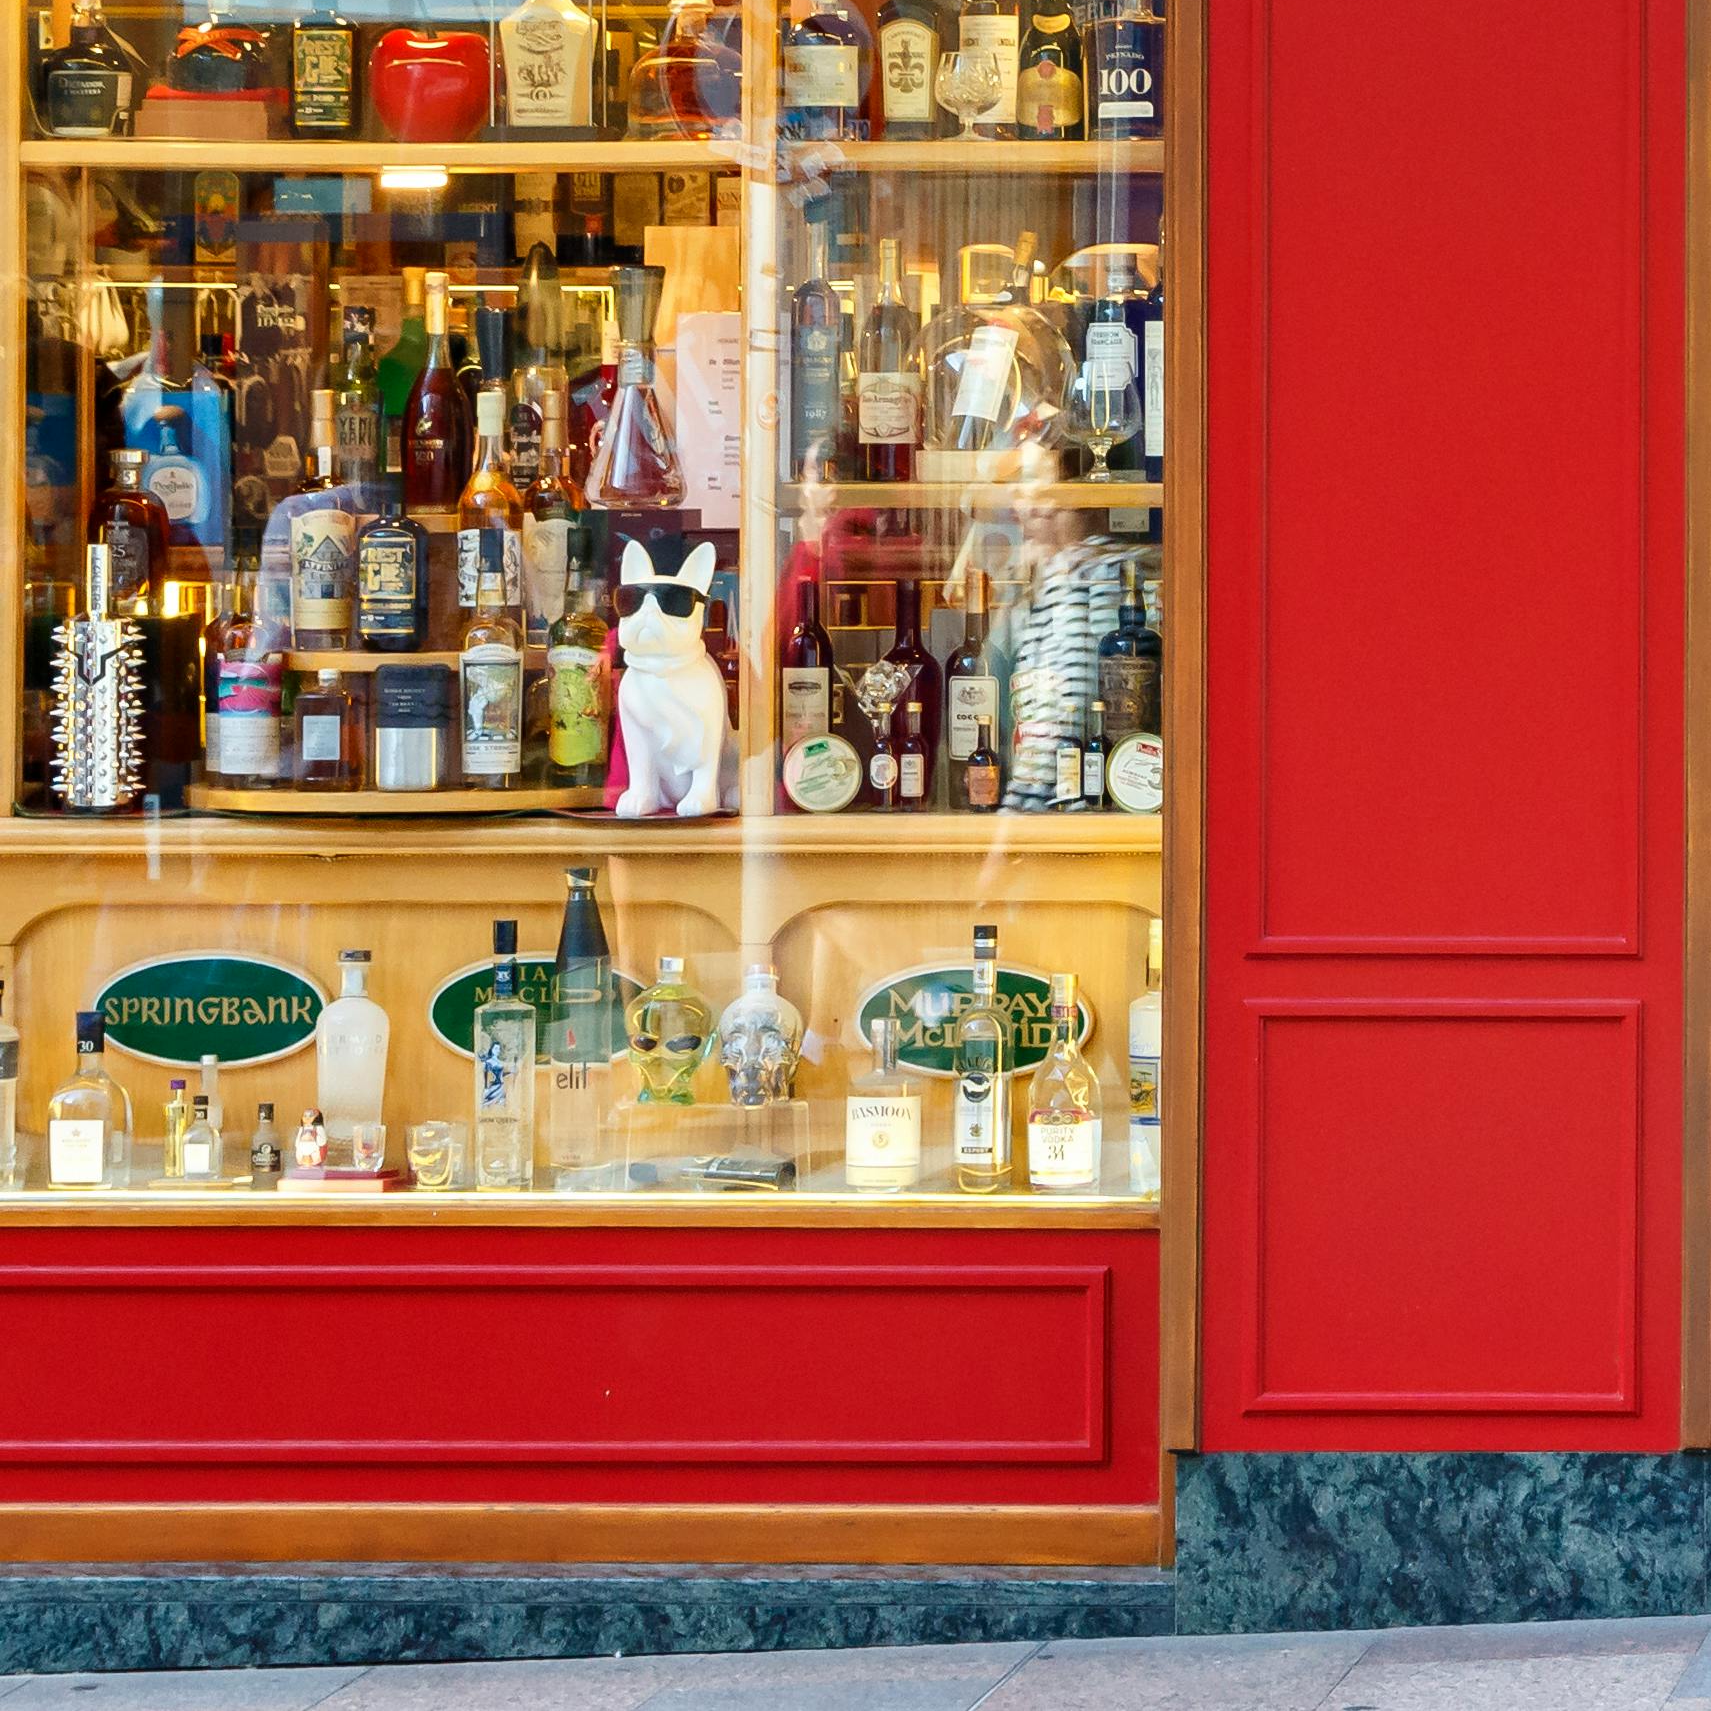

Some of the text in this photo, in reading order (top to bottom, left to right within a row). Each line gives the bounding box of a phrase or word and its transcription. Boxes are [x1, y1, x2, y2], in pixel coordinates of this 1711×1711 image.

[1100, 68, 1152, 96] 100
[104, 995, 314, 1026] SPRINGBANK
[77, 1040, 94, 1053] 30
[556, 1061, 591, 1090] elit
[1040, 1127, 1075, 1135] PURITY
[1042, 1135, 1075, 1144] VODKA
